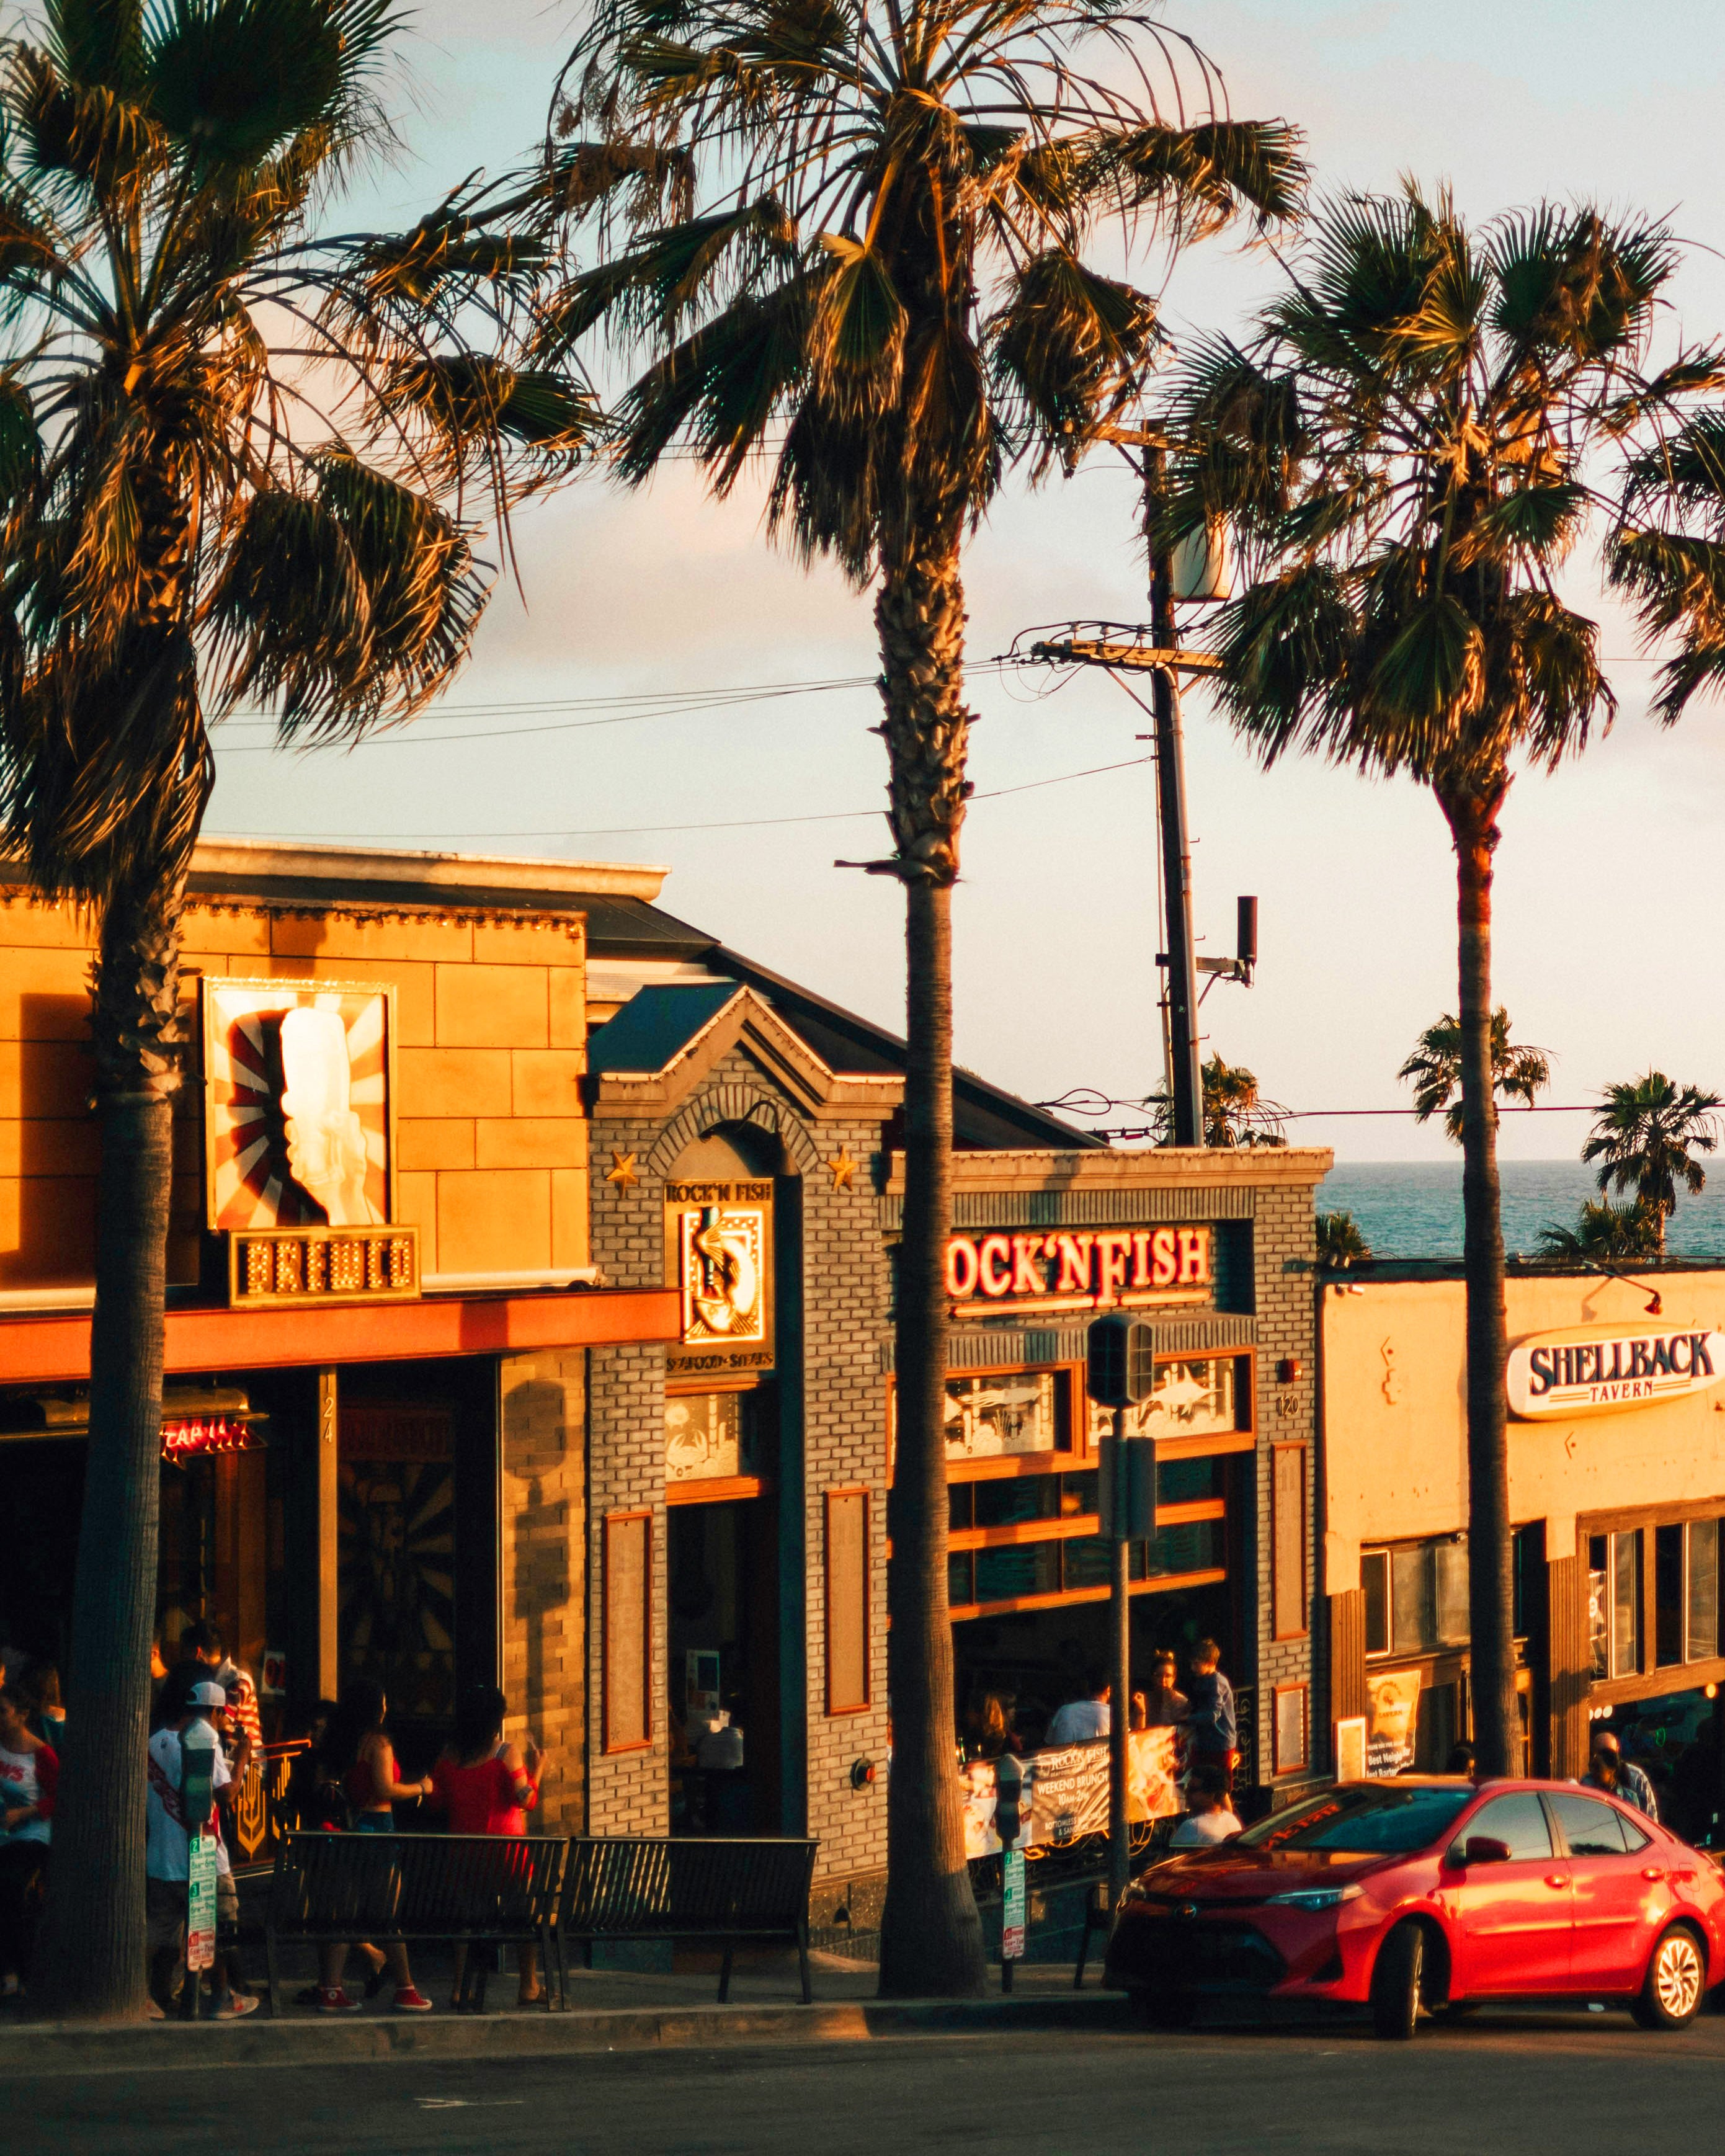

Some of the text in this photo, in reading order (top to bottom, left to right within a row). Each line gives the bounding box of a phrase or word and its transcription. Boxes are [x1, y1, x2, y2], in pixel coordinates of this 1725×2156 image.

[666, 1183, 772, 1202] ROCK'N FISH
[247, 1239, 412, 1294] BREWCO
[947, 1234, 1094, 1296] OCK'N
[1529, 1332, 1716, 1396] SHELLBACK
[1590, 1381, 1654, 1402] TAVERN
[1276, 1395, 1299, 1417] 120
[1368, 1755, 1382, 1766] Best
[1037, 1771, 1108, 1795] WEEKEND BRUNCH
[1045, 1815, 1077, 1830] BOTTOMLESS
[192, 1840, 198, 1853] 2
